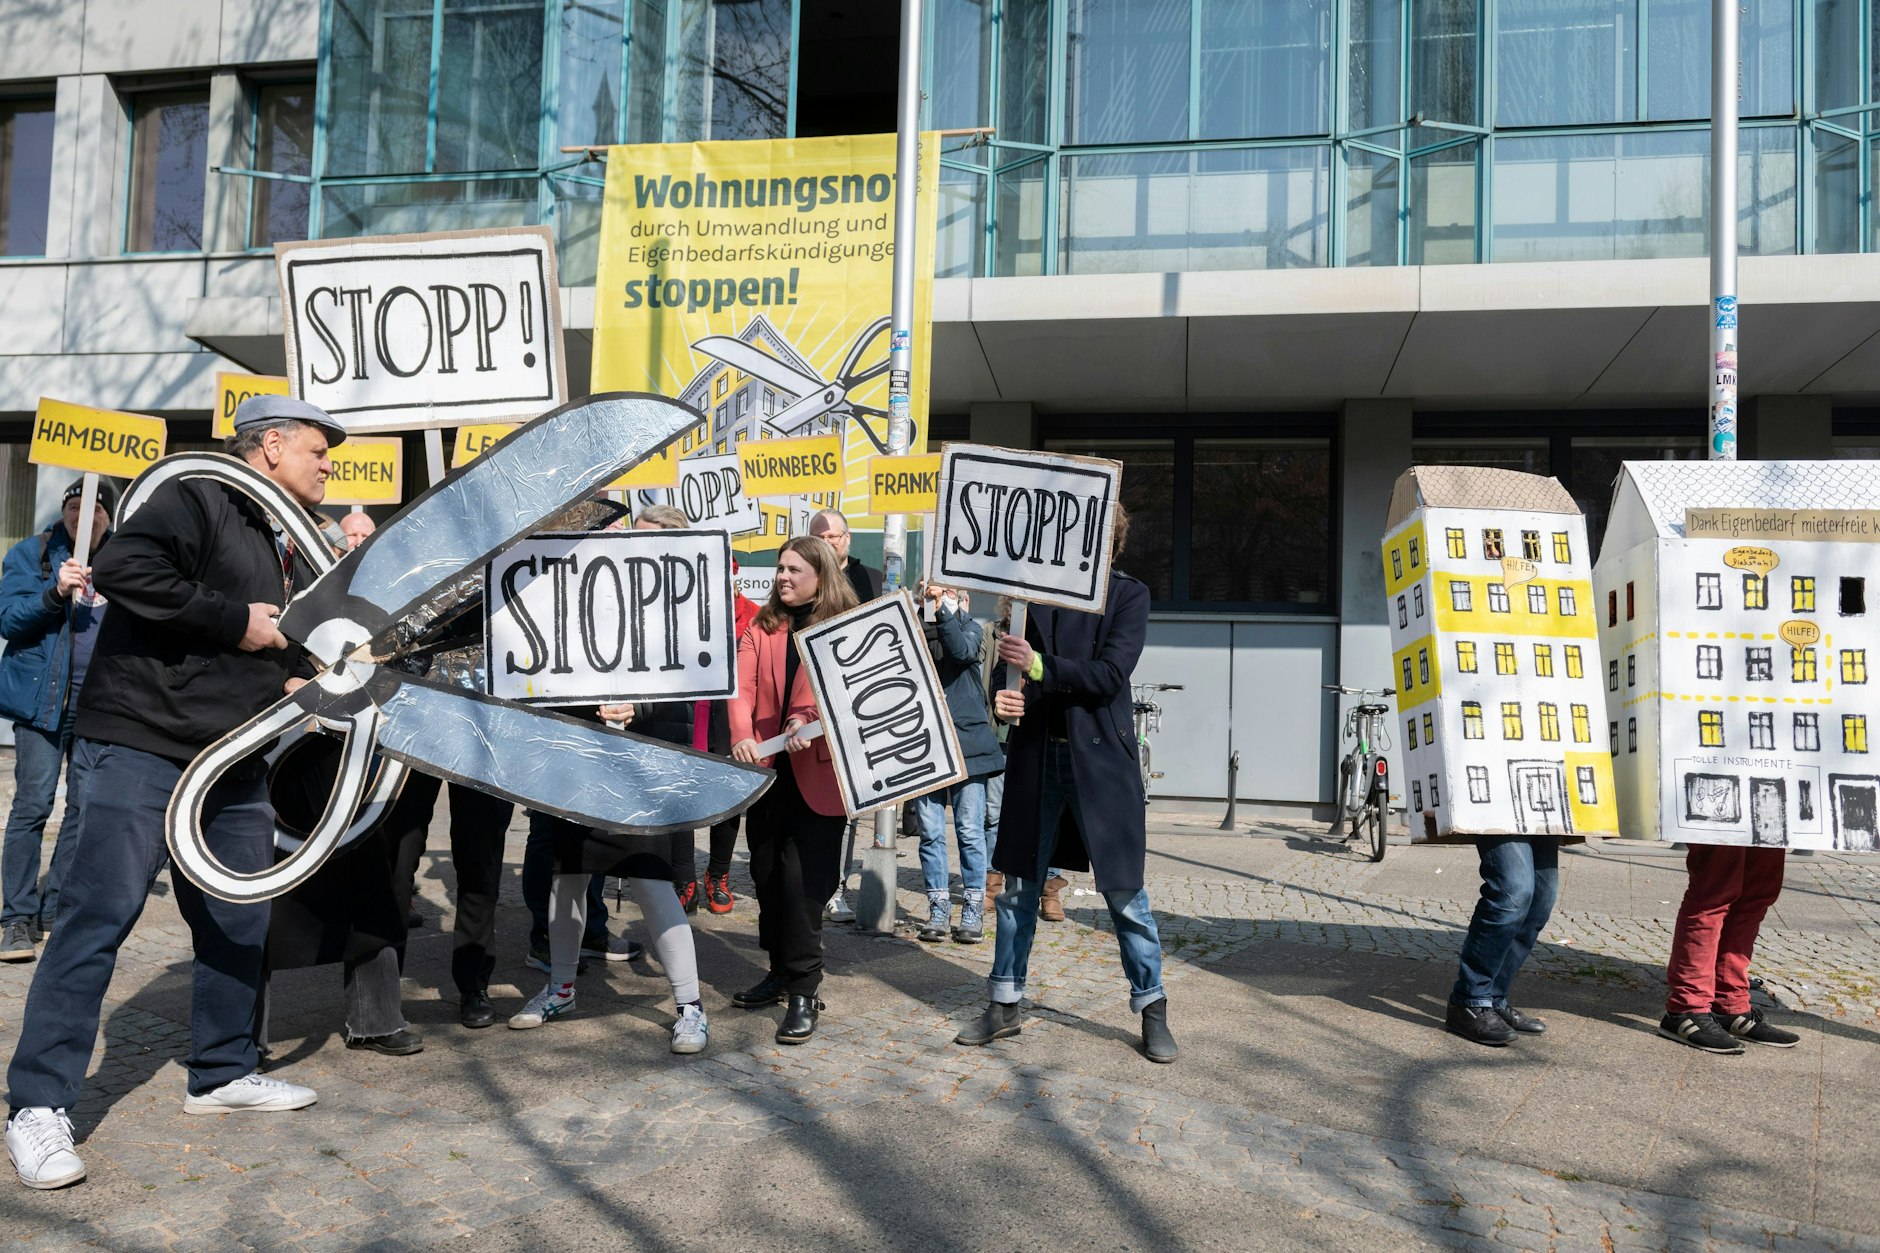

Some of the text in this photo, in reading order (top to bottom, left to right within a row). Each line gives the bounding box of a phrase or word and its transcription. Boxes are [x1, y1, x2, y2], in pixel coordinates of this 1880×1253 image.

[634, 173, 896, 212] Wohnungsno
[630, 213, 887, 238] durch Umwandlung und
[624, 267, 800, 314] stoppen!
[305, 281, 536, 385] STOPP!
[37, 418, 161, 462] HAMBURG
[325, 460, 394, 483] REMEN
[744, 452, 837, 479] NÜRNBERG
[953, 481, 1099, 572] STOPP!
[1691, 514, 1719, 531] Dank
[1721, 513, 1797, 537] Eigenbedarf
[1802, 516, 1868, 534] mieterfreie
[1507, 559, 1535, 573] HILFE!
[501, 553, 712, 675] STOPP!
[1787, 627, 1816, 638] HILFE!
[829, 623, 936, 792] STOPP!
[1691, 756, 1793, 769] TOLLE INSTRUMENTE
